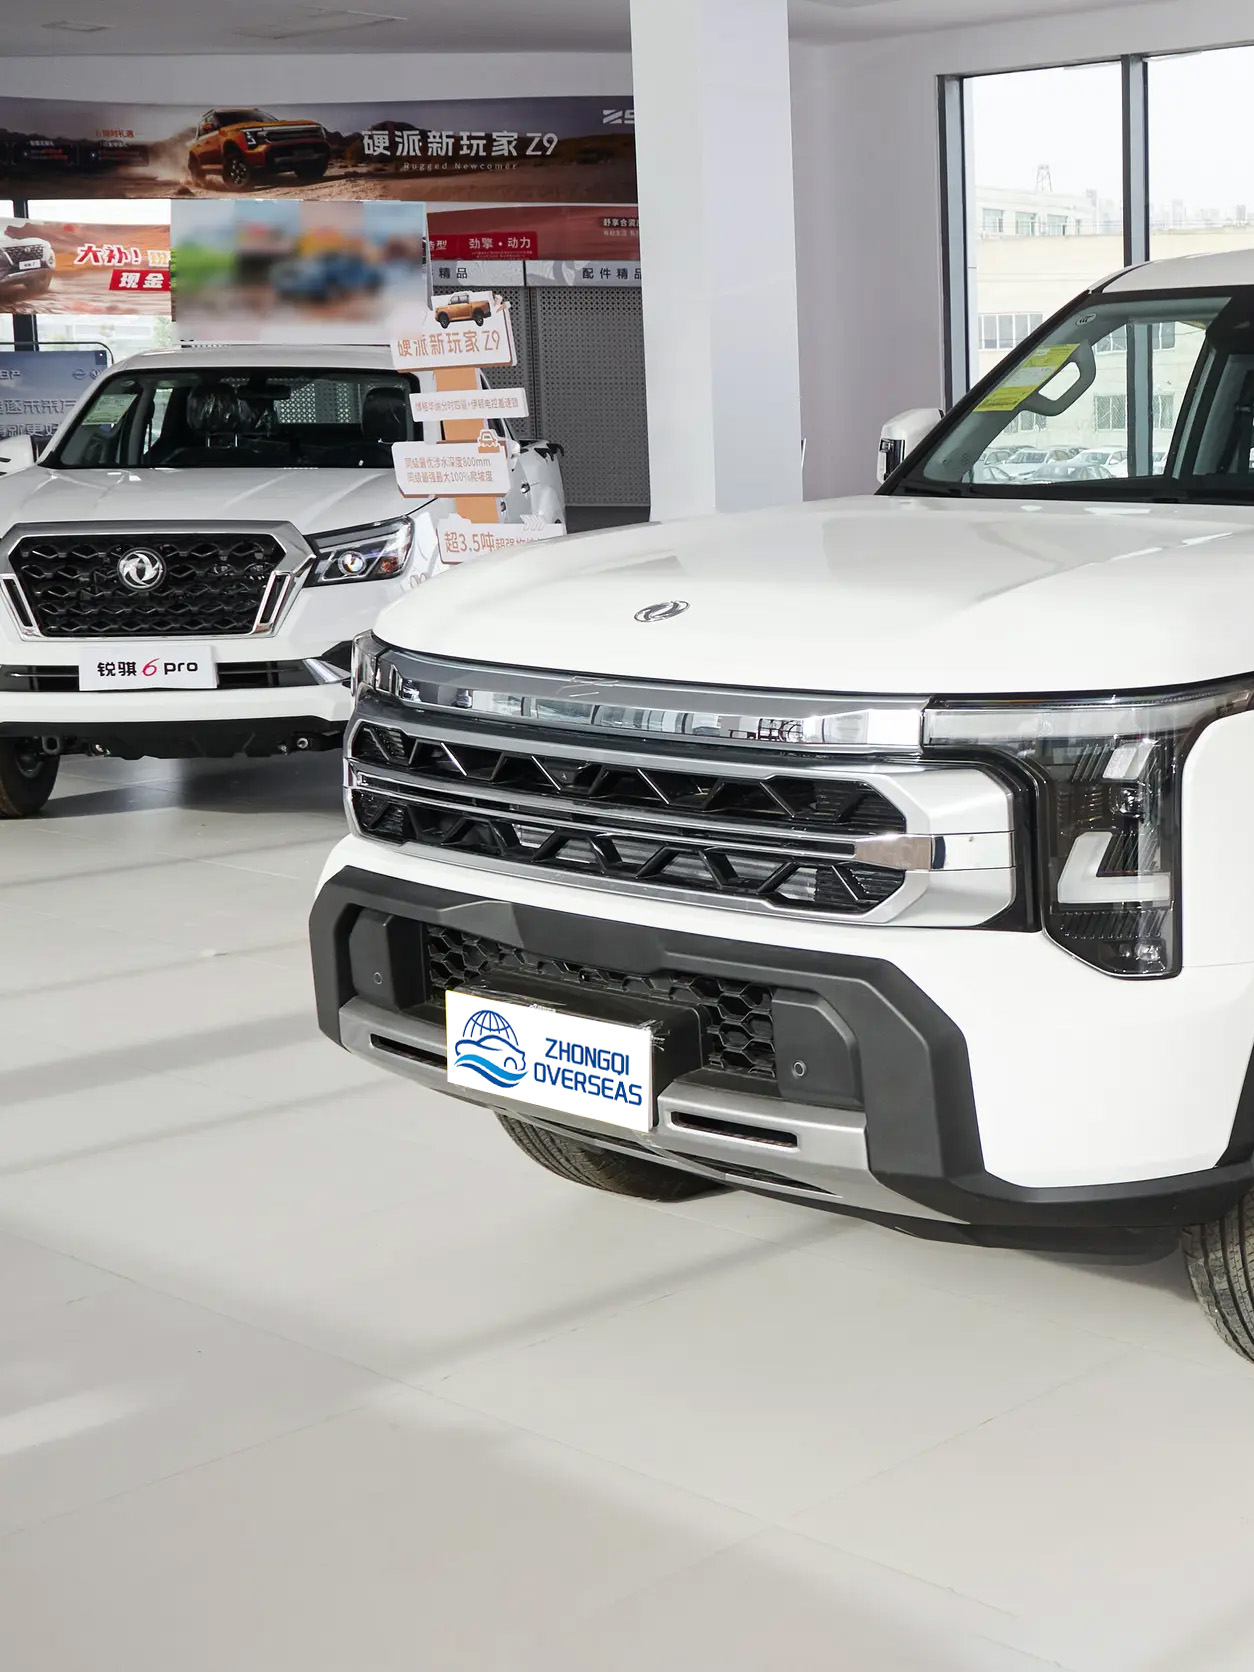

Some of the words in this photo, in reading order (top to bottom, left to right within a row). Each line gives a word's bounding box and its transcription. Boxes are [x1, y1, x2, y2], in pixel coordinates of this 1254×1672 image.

[362, 130, 519, 157] 硬派新玩家
[525, 132, 559, 156] Z9
[403, 161, 448, 171] Rugged
[454, 161, 518, 170] Newcomer
[118, 272, 171, 289] 现金
[431, 267, 468, 279] 精品
[397, 331, 480, 357] 硬派新玩家
[482, 329, 501, 351] Z9
[97, 661, 137, 677] 锐骐
[140, 657, 161, 677] 6
[163, 661, 199, 675] pro
[545, 1037, 630, 1076] ZHONGQI
[533, 1061, 643, 1106] OVERSEAS
